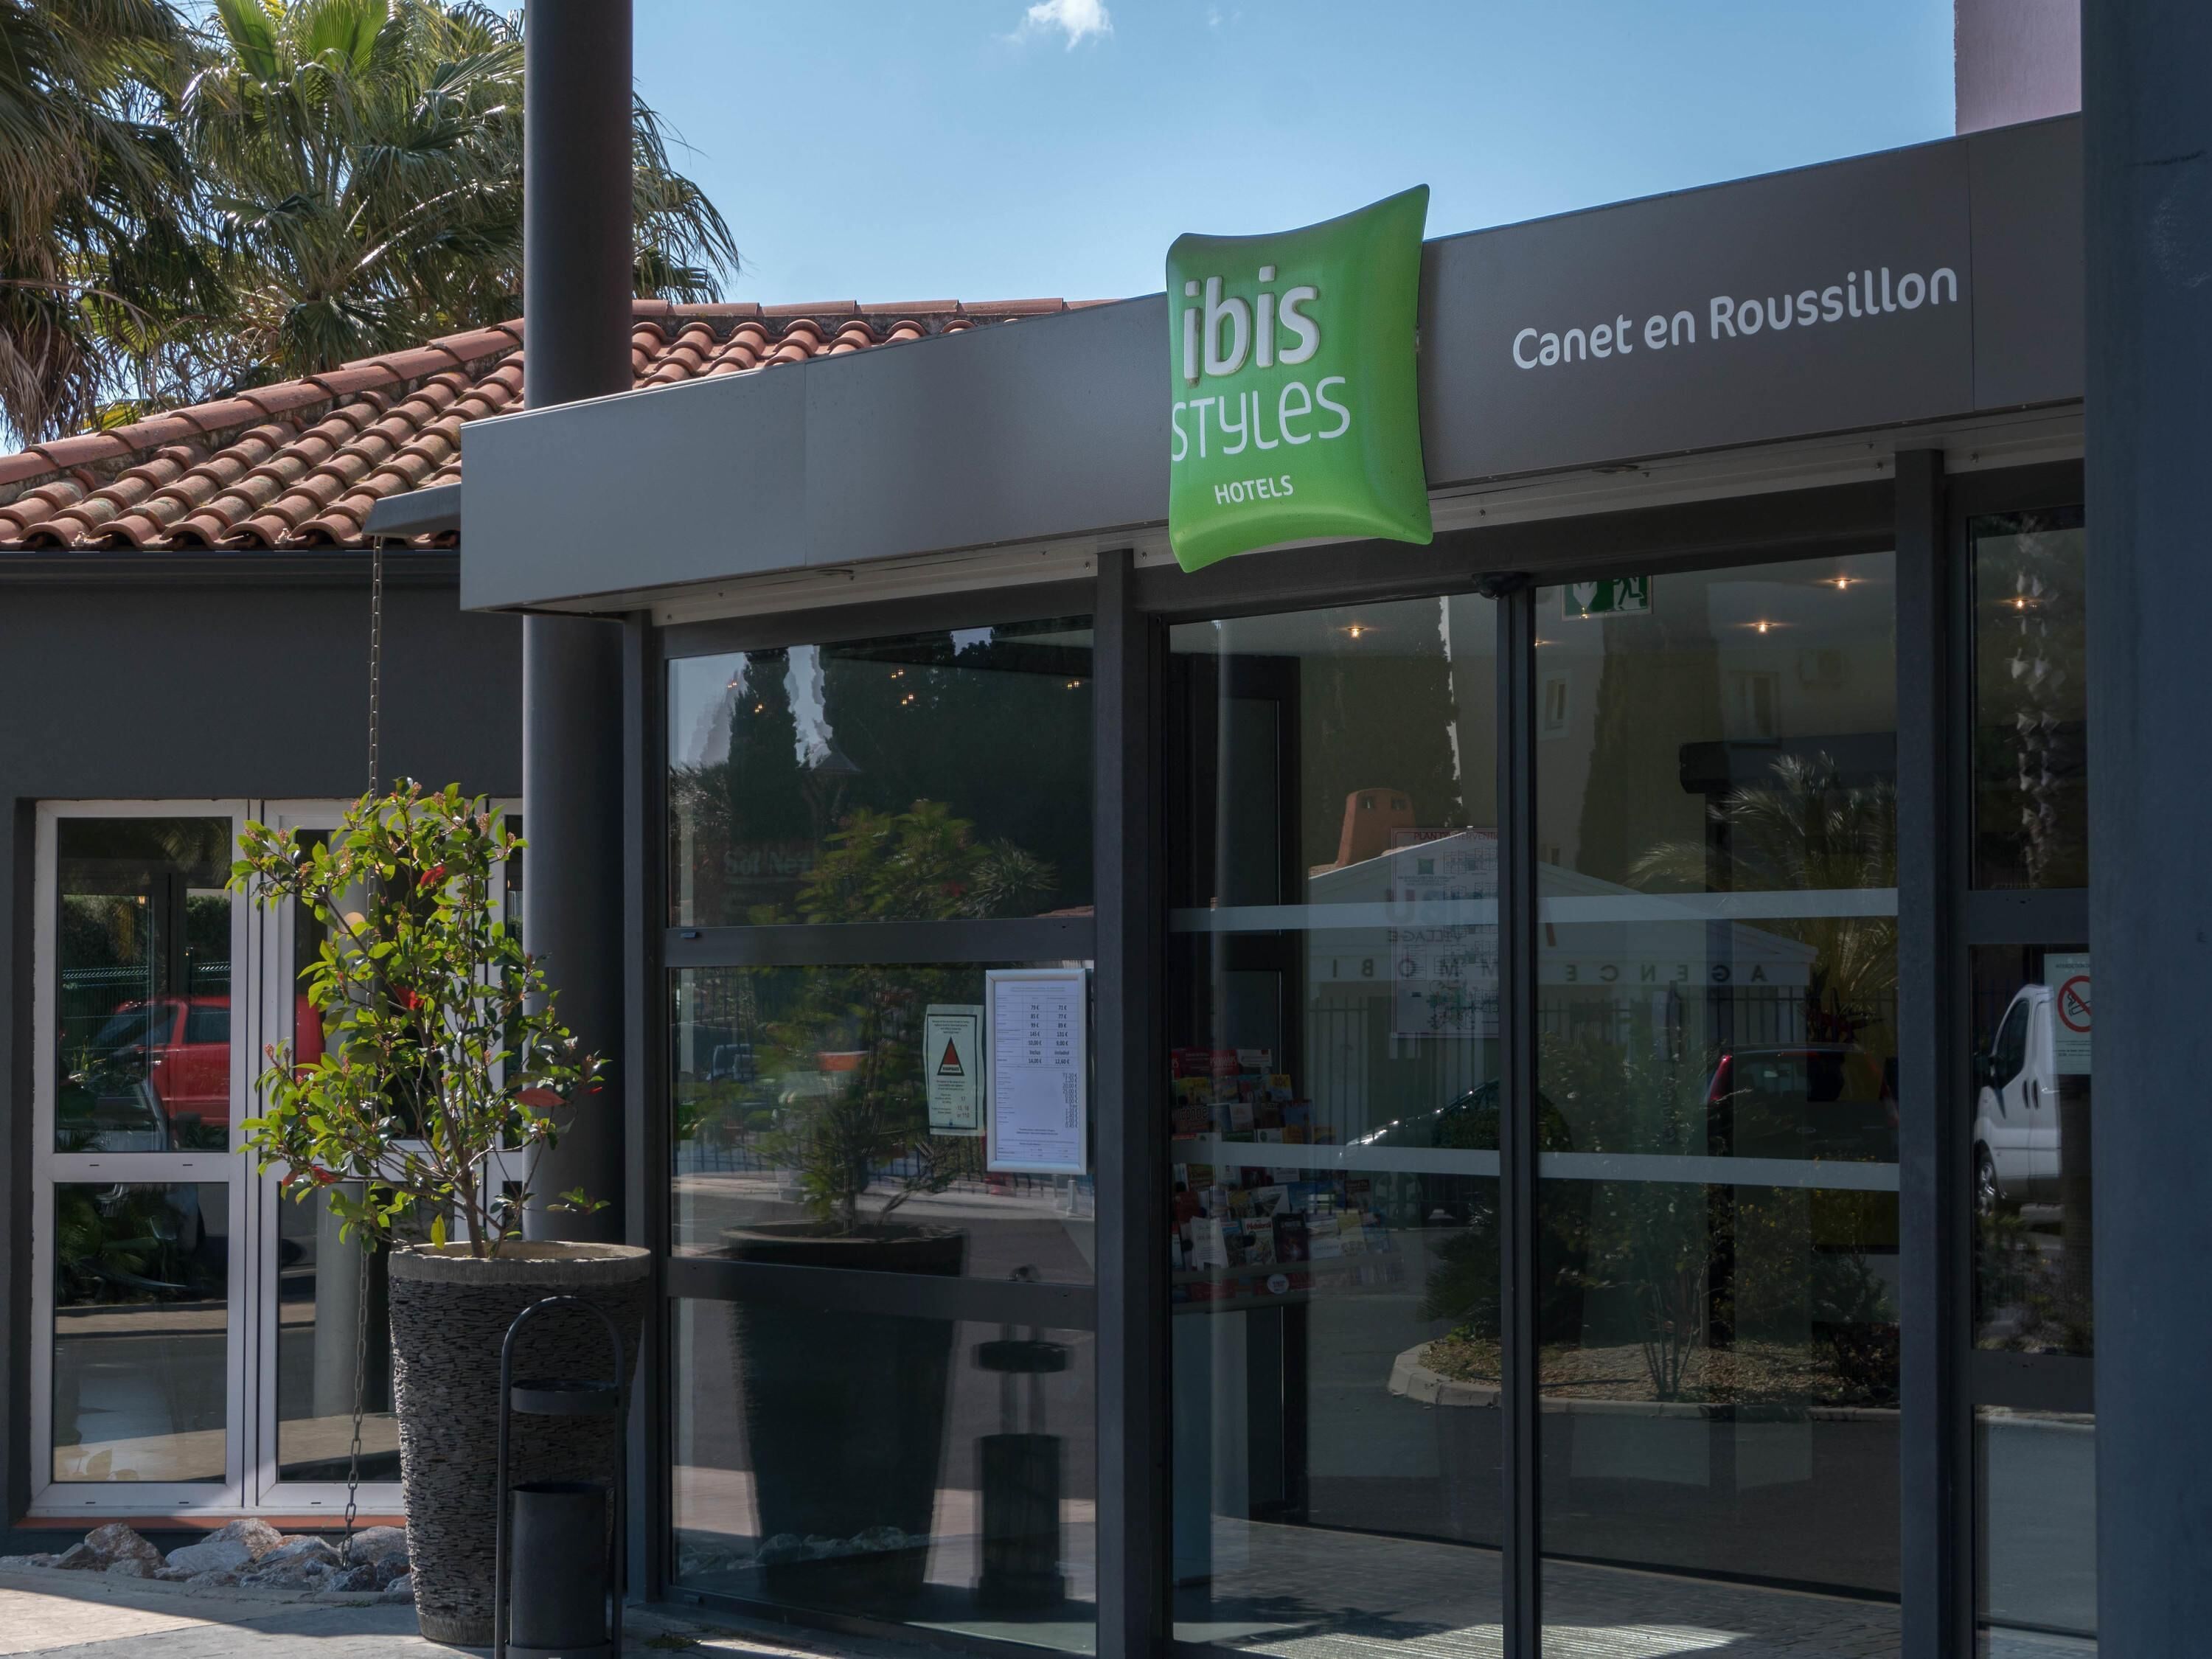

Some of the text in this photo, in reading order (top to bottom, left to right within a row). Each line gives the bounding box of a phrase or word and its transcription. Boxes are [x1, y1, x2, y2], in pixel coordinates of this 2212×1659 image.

[1183, 265, 1321, 380] ibis
[1512, 266, 1958, 370] Canet en Roussillon
[1214, 474, 1294, 505] HOTELS
[1414, 832, 1437, 840] PLAN
